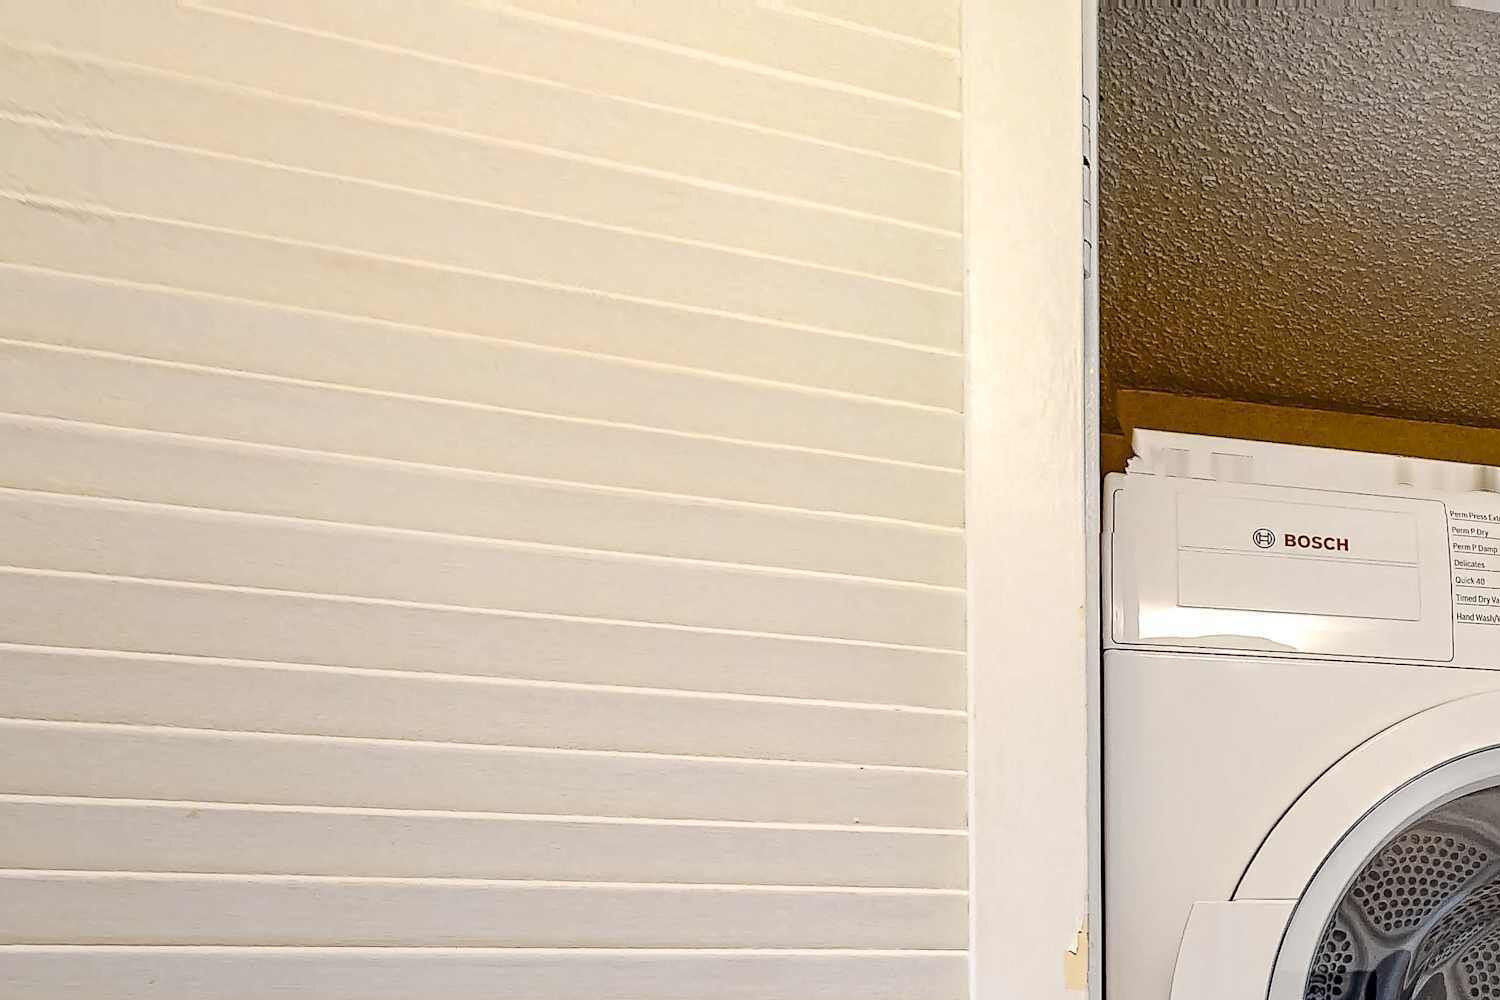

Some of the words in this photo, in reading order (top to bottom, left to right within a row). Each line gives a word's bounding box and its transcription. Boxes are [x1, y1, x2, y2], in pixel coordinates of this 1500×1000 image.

[1450, 511, 1468, 519] Perm
[1470, 512, 1488, 521] Press
[1452, 527, 1469, 535] Perm
[1477, 529, 1488, 537] Dry
[1284, 534, 1349, 551] BOSCH
[1453, 543, 1470, 551] Perm
[1478, 545, 1498, 555] Damp
[1454, 560, 1485, 569] Delicates
[1456, 577, 1475, 586] Quick
[1456, 594, 1476, 603] Timed
[1478, 595, 1490, 604] Dry
[1457, 613, 1474, 621] Hand
